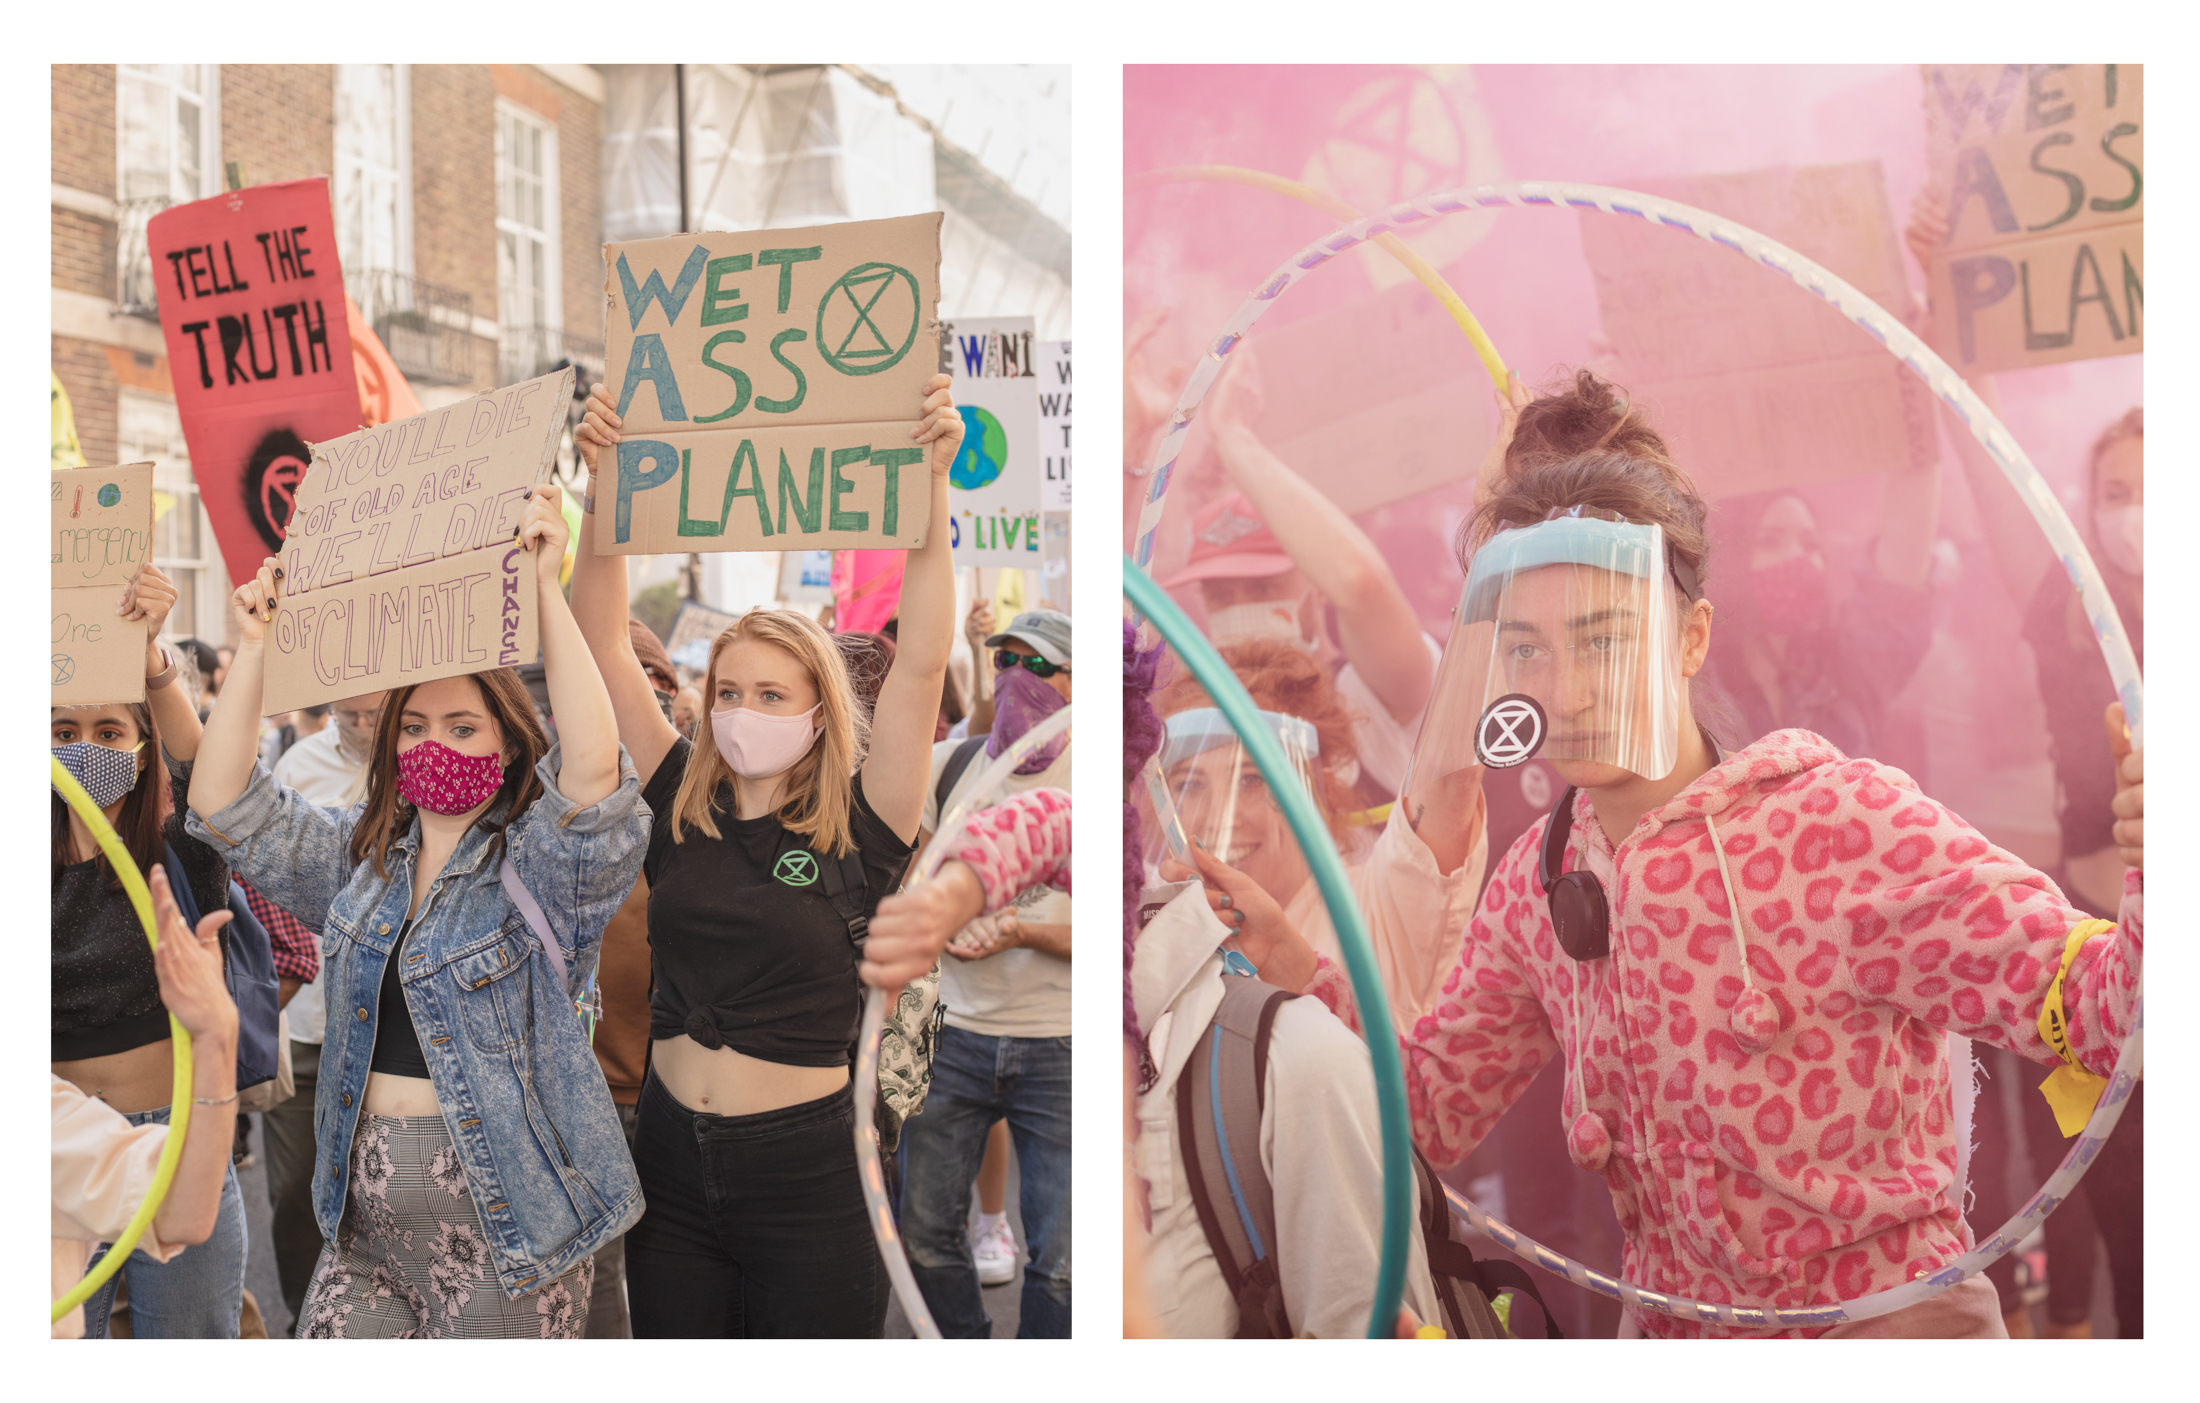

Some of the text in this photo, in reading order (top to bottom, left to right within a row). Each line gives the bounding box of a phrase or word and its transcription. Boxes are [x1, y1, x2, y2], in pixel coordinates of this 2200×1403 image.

[1943, 123, 2142, 246] ASS
[166, 226, 316, 301] TELL THE
[615, 244, 823, 333] WET
[181, 299, 332, 389] TRUTH
[615, 327, 808, 424] ASS
[323, 382, 542, 493] YOU'LL DIE
[287, 486, 527, 597] WE'LL DIE
[305, 456, 490, 537] OF OLD AGE
[612, 438, 925, 545] PLANET
[975, 515, 1038, 551] LIVE
[276, 572, 491, 687] OF CLIMATE
[499, 548, 521, 666] CHANGE
